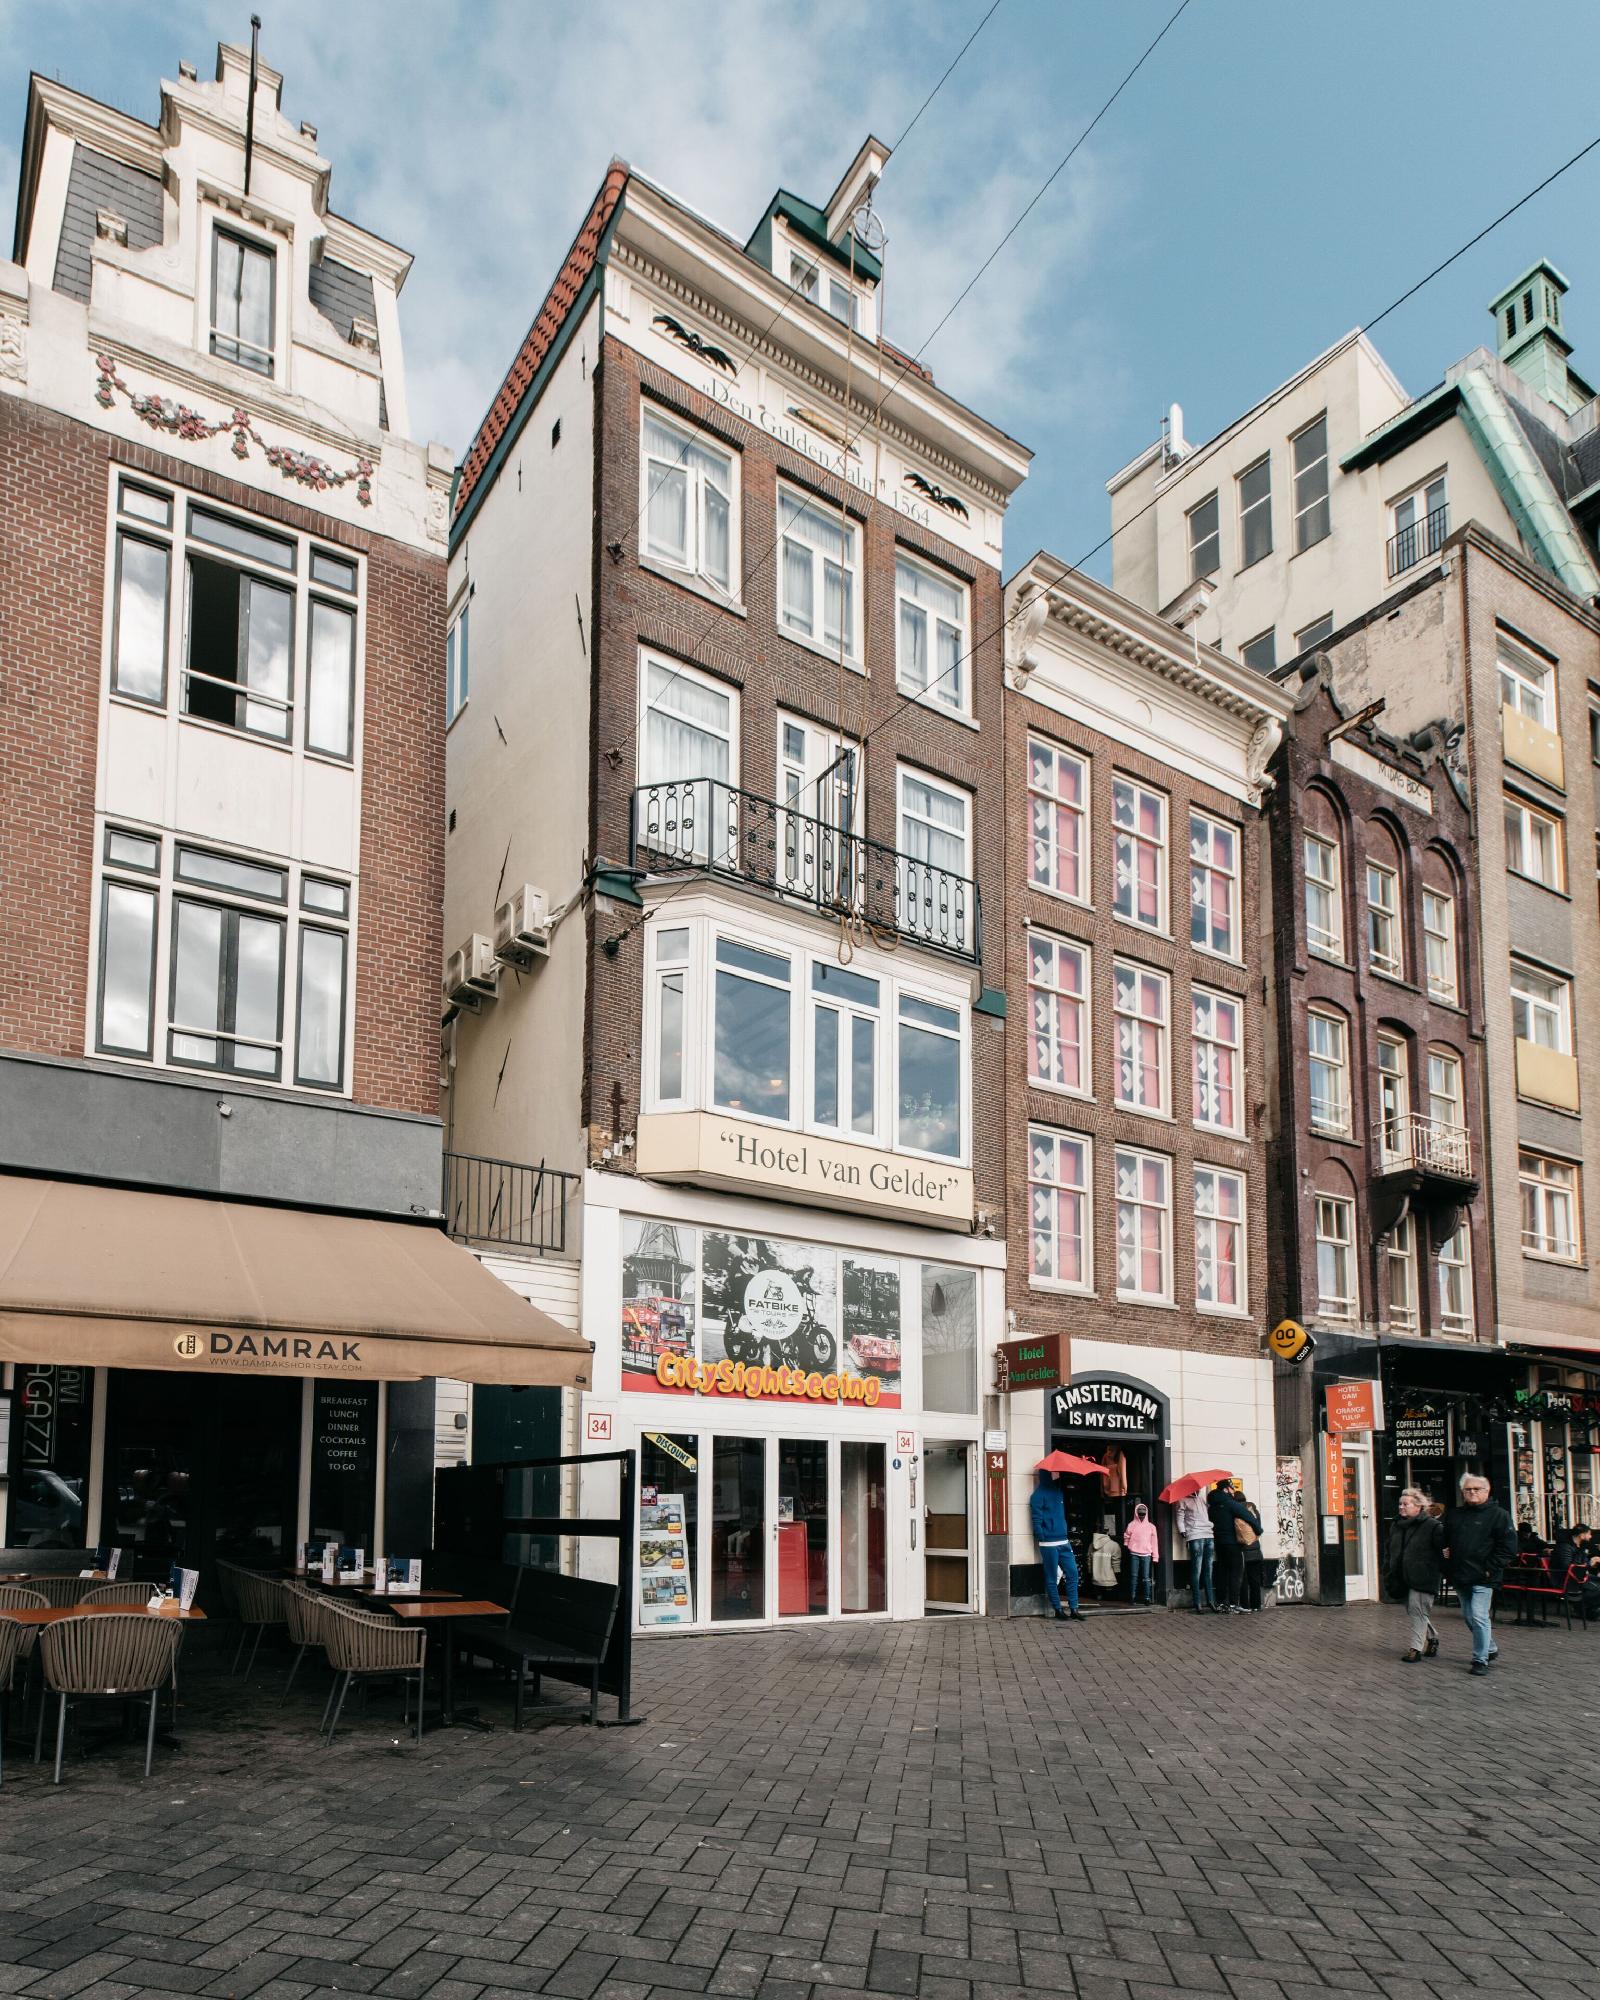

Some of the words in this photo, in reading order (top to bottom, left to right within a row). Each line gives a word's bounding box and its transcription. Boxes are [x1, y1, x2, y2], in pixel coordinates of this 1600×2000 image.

[760, 411, 829, 467] Gulden
[893, 490, 930, 527] 1564
[818, 1158, 861, 1185] van
[748, 1299, 799, 1313] FATBIKE
[210, 1333, 362, 1361] DAMRAK
[1018, 1344, 1045, 1361] Hotel
[1296, 1345, 1311, 1361] cash
[656, 1351, 881, 1407] CitySightseeing
[1338, 1385, 1360, 1393] HOTEL
[320, 1396, 368, 1406] BREAKFAST
[1055, 1384, 1158, 1420] AMSTERDAM
[329, 1409, 359, 1419] LUNCH
[1336, 1406, 1366, 1415] ORANGE
[1069, 1411, 1082, 1426] IS
[1086, 1412, 1106, 1428] MY
[1108, 1414, 1145, 1430] STYLE
[1342, 1413, 1361, 1421] TULIP
[327, 1422, 360, 1432] DINNER
[592, 1419, 608, 1433] 34
[1396, 1420, 1416, 1429] COFFEE
[1422, 1419, 1445, 1428] OMELET
[319, 1436, 367, 1445] COCKTAILS
[900, 1437, 911, 1448] 34
[1396, 1438, 1445, 1447] PANCAKES
[327, 1449, 359, 1458] COFFEE
[656, 1434, 690, 1464] DISCOUNT
[1396, 1448, 1445, 1456] BREAKFAST
[328, 1463, 341, 1471] TO
[342, 1463, 356, 1471] GO
[991, 1455, 1004, 1469] 34
[1330, 1451, 1339, 1512] HOTEL
